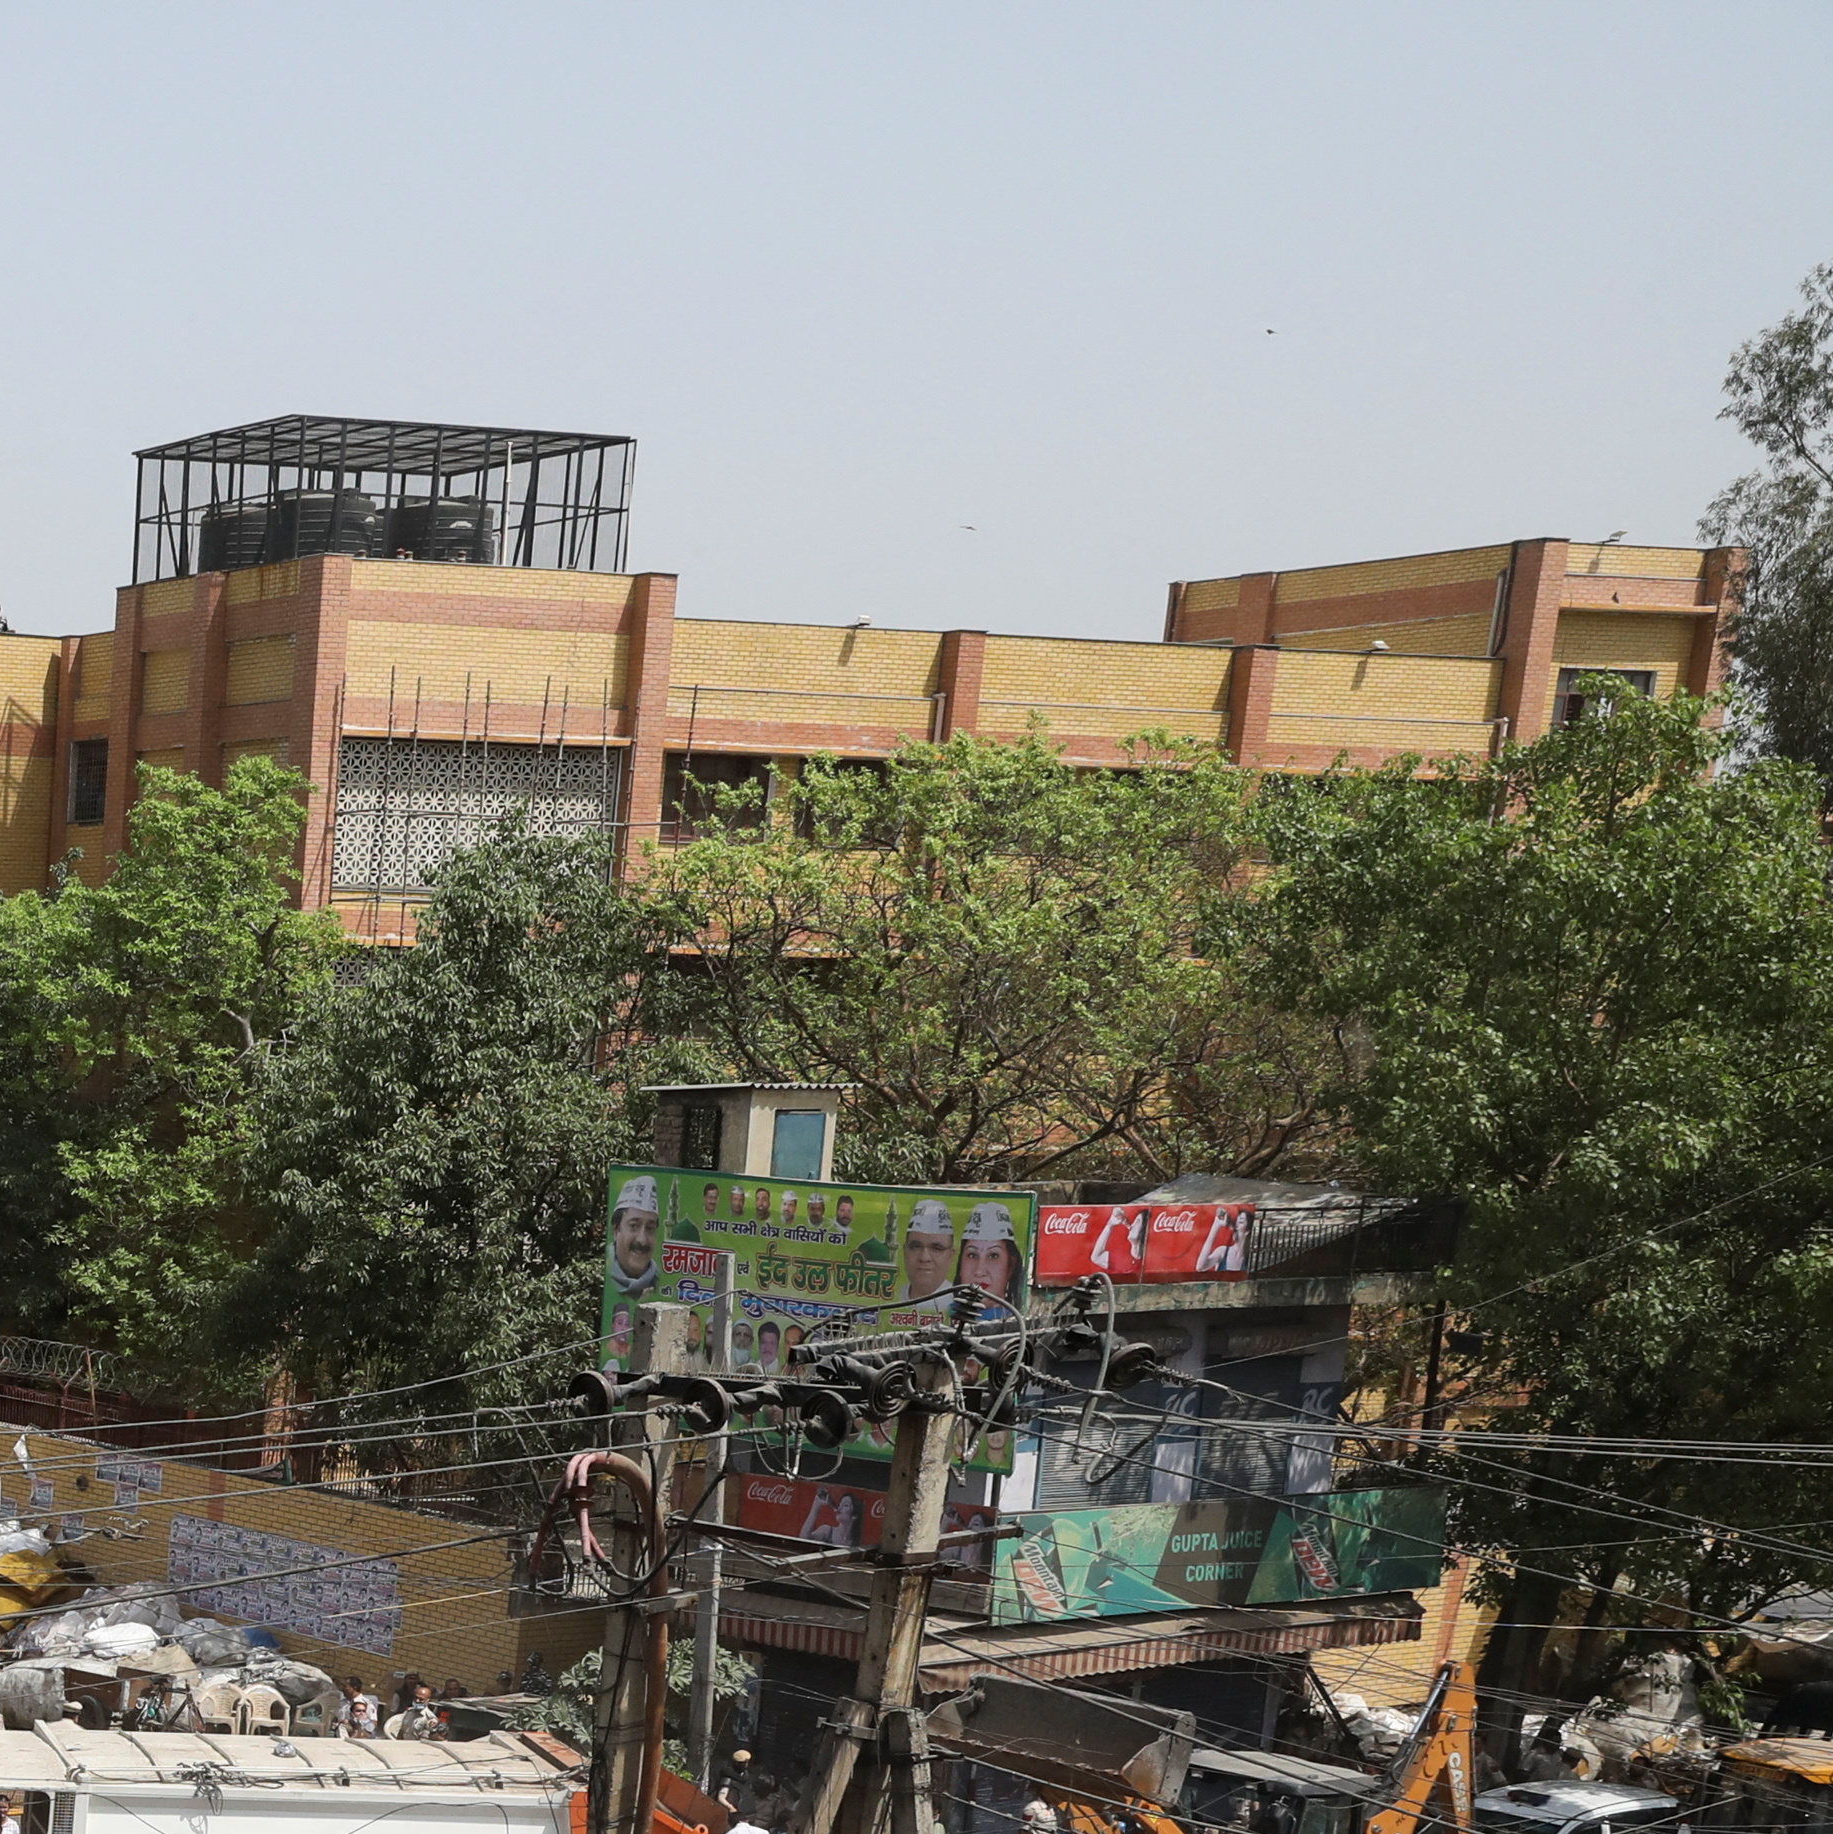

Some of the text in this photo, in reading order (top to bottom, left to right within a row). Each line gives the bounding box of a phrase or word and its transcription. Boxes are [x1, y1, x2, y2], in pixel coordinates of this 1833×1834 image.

[1171, 1529, 1263, 1553] GUPTA JUICE
[1185, 1562, 1244, 1583] CORNER
